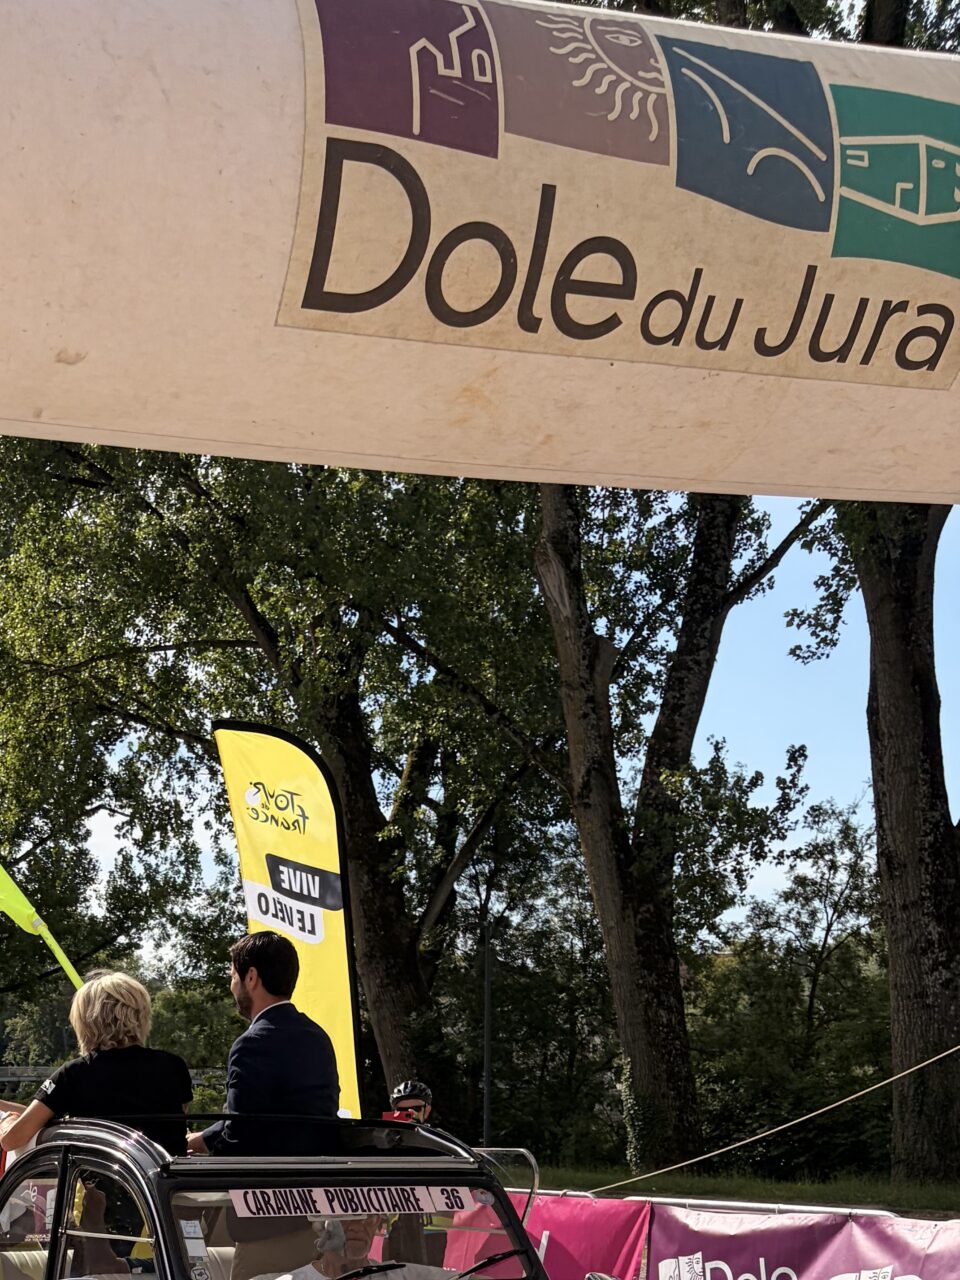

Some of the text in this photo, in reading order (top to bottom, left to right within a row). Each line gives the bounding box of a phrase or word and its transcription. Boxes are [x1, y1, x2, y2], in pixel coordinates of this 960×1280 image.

[301, 137, 957, 372] Dole du Jura
[242, 1187, 425, 1217] CARAVANE PUBLICITAIRE
[440, 1187, 465, 1211] 36
